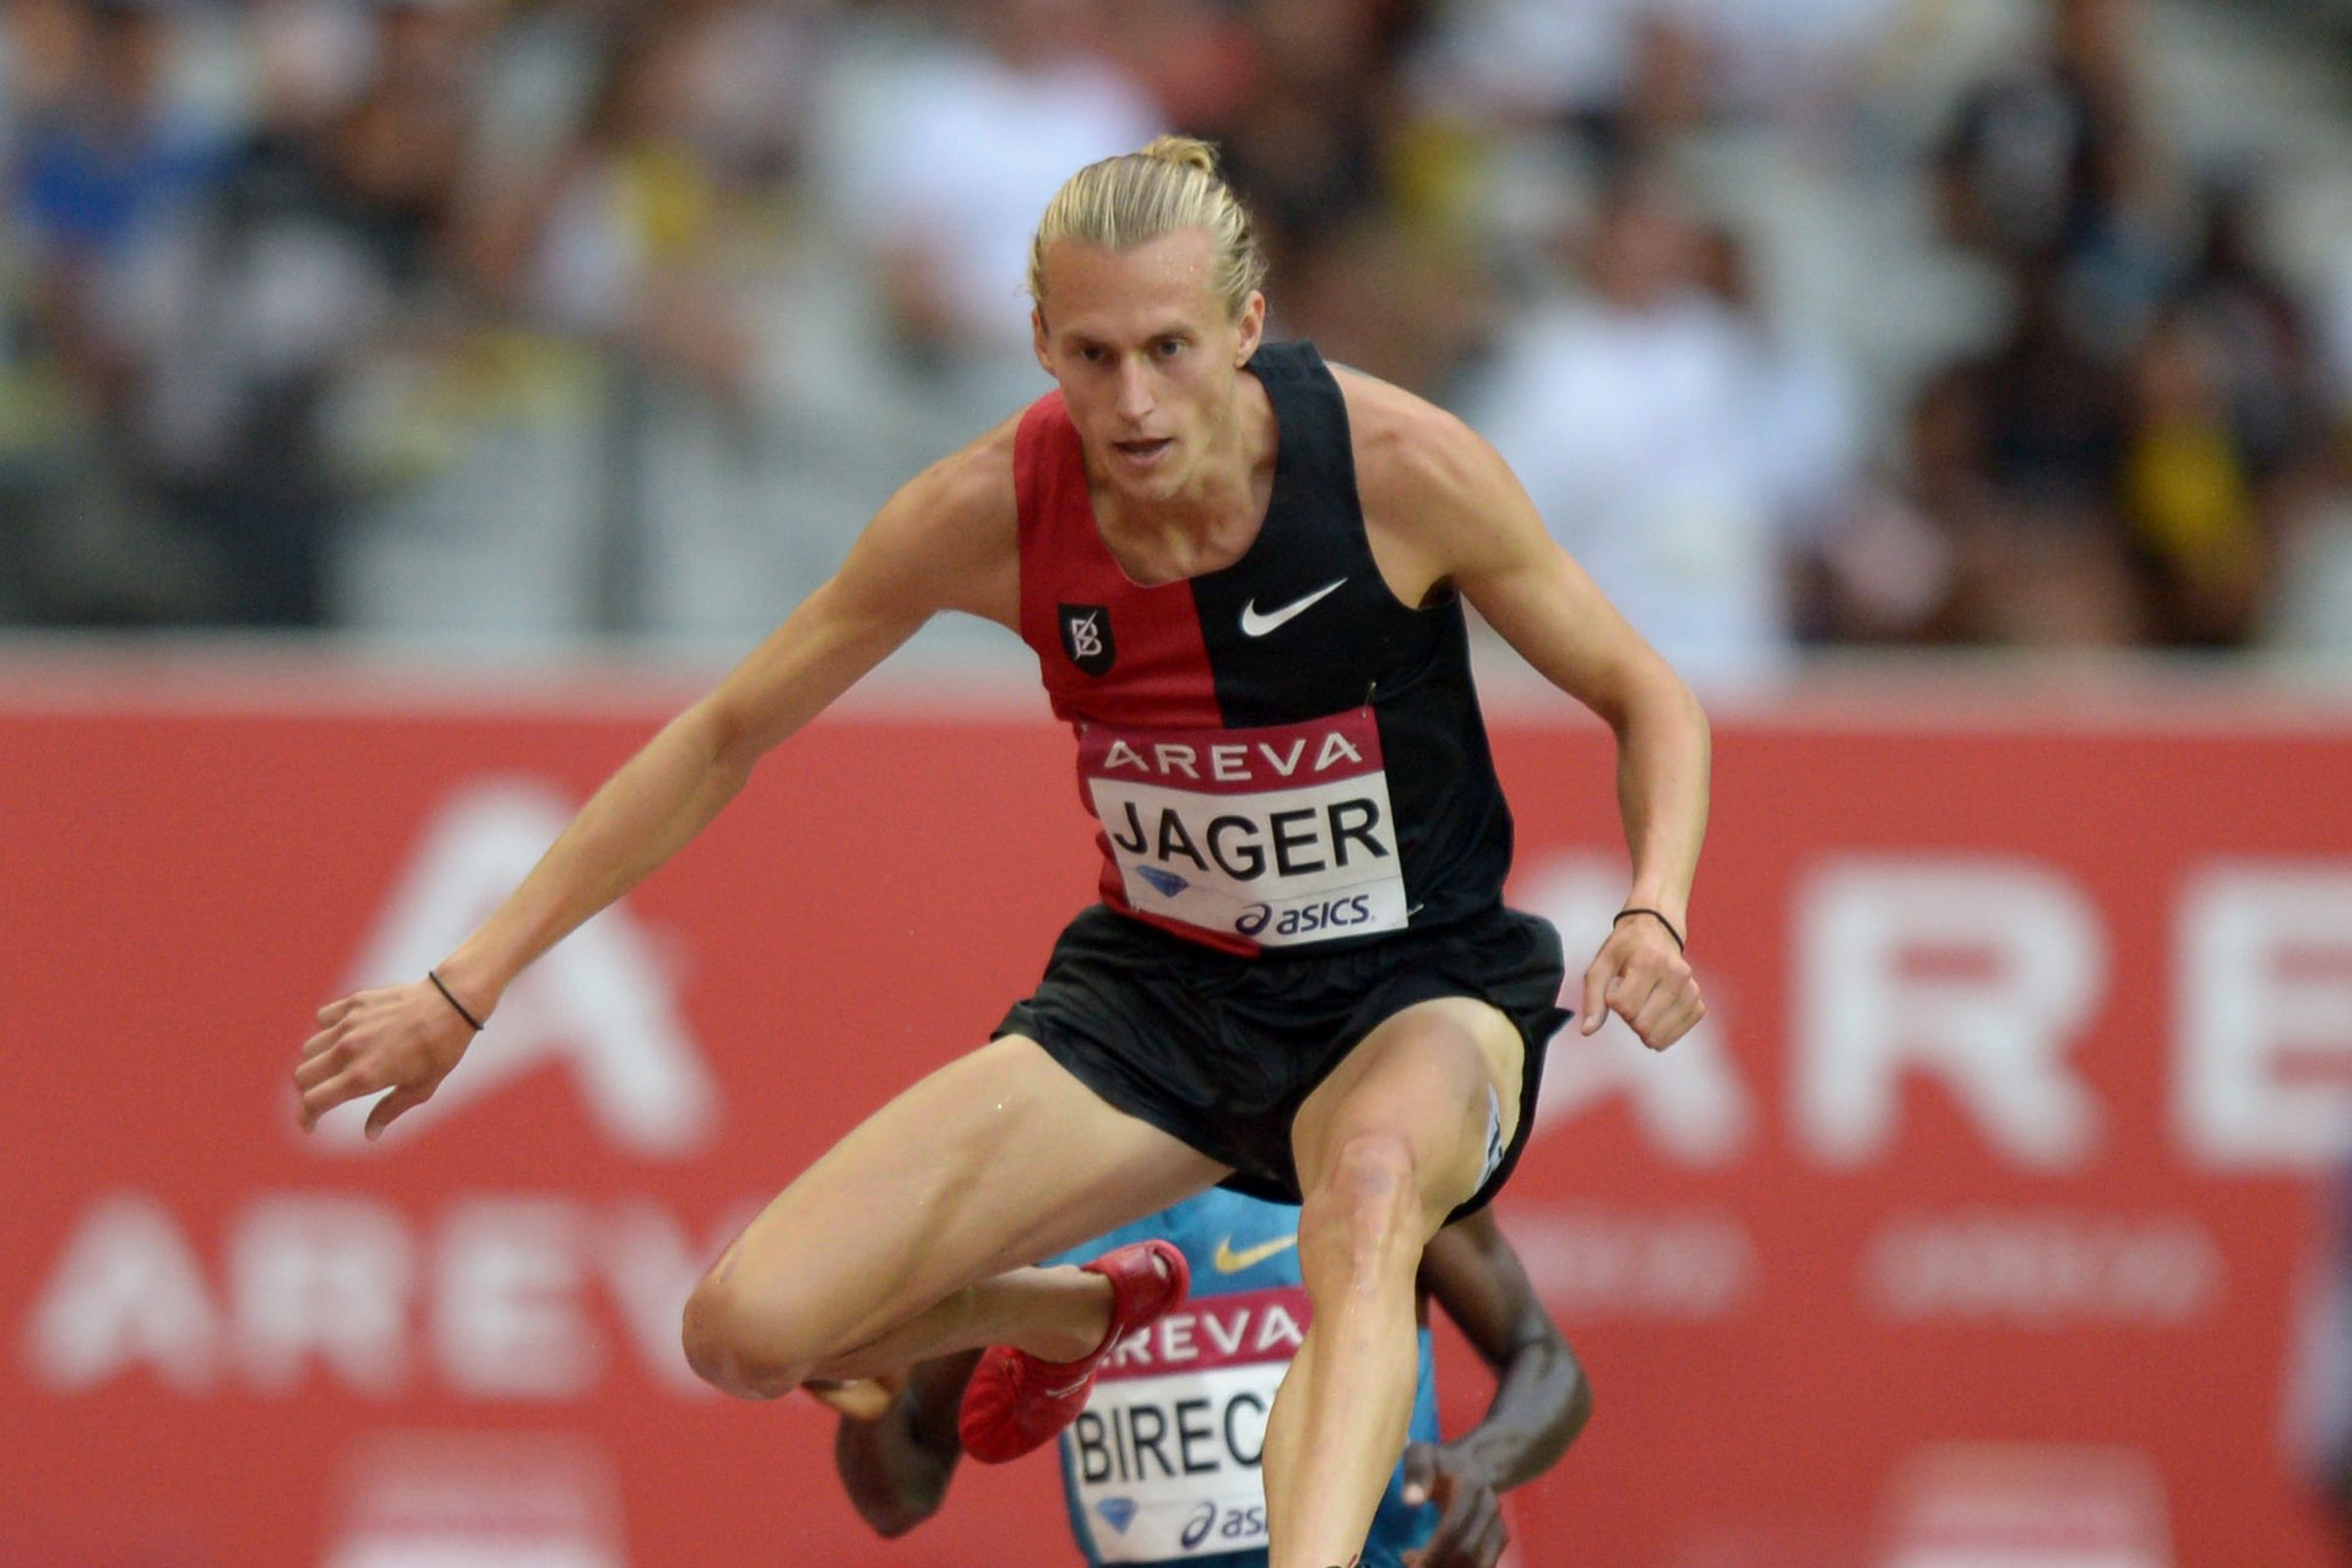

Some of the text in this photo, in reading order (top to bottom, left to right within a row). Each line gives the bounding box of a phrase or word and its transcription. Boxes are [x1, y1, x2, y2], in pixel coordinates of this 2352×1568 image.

[1103, 731, 1362, 782] AREVA
[1113, 796, 1390, 882] JAGER
[31, 1196, 764, 1396] AREV
[1101, 1305, 1303, 1366] REVA
[1076, 1393, 1266, 1485] BIREC
